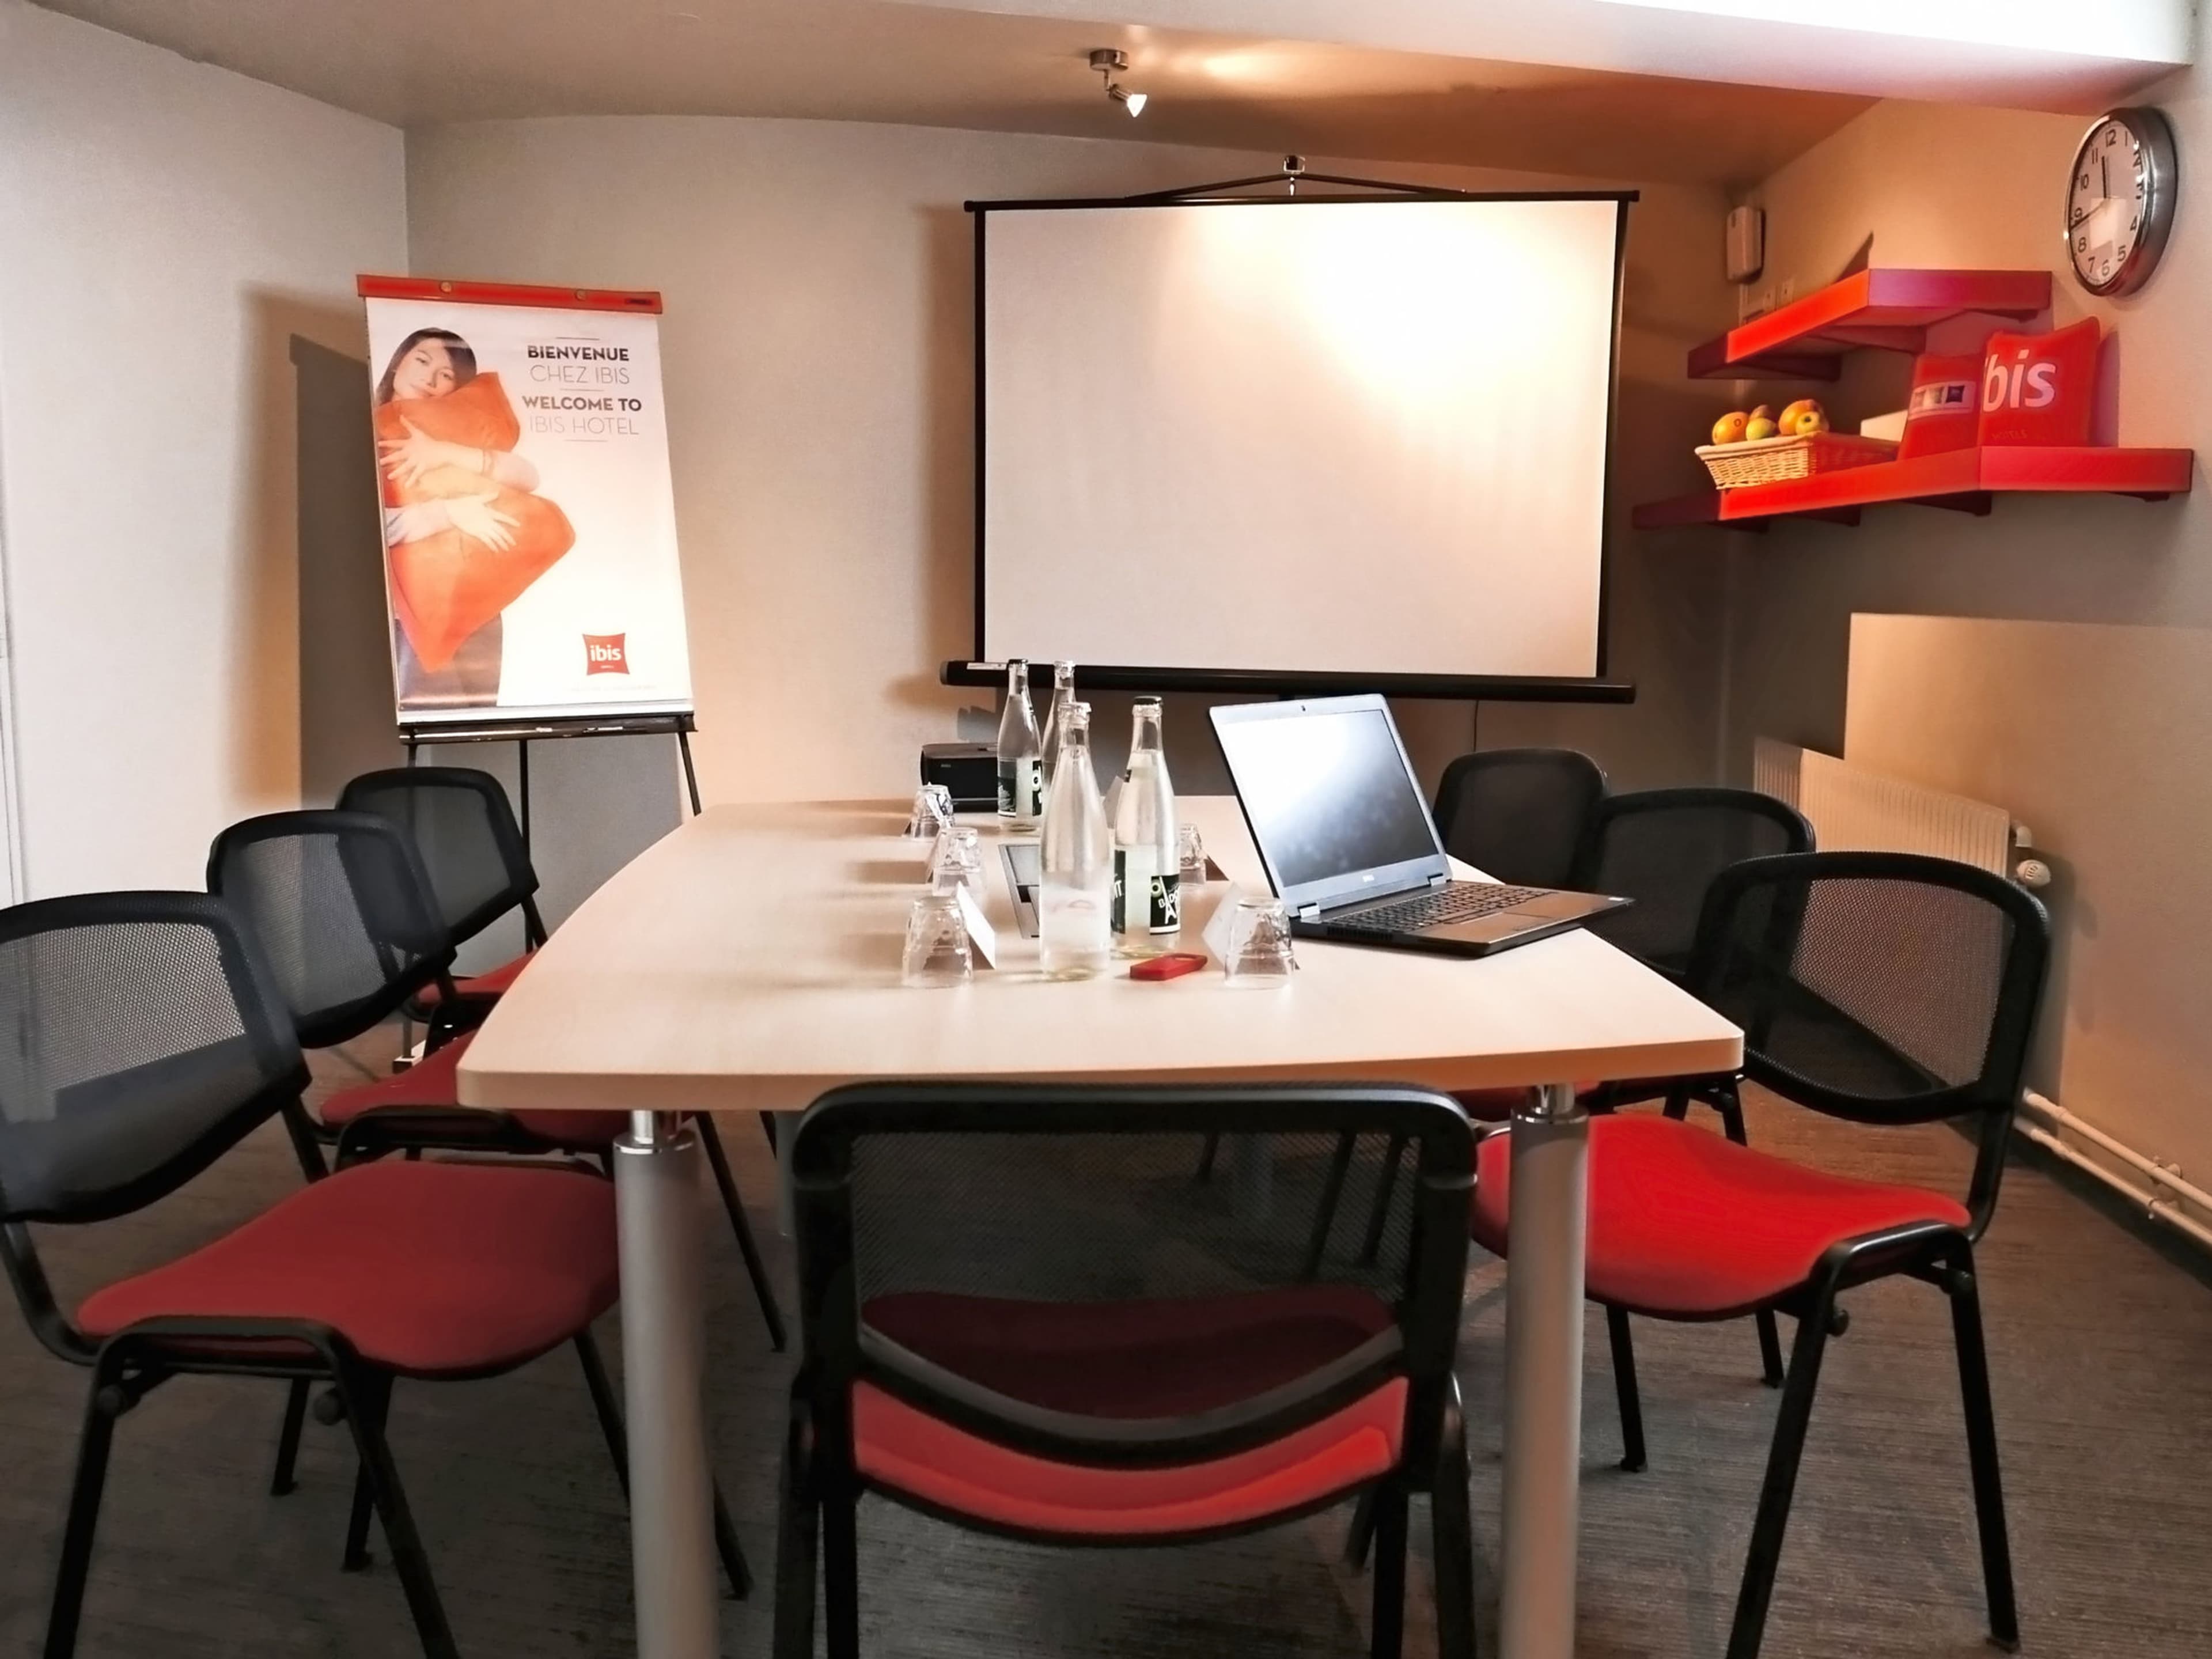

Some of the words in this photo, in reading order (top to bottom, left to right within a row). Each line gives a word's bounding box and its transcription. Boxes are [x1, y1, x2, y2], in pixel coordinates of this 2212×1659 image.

[2105, 129, 2116, 147] 12
[2124, 130, 2128, 146] 1
[2092, 148, 2099, 164] 11
[2081, 174, 2089, 191] 10
[2130, 215, 2138, 232] 4
[2078, 237, 2086, 252] 8
[2118, 245, 2126, 262] 5
[2088, 257, 2095, 273] 7
[2101, 260, 2110, 276] 6
[528, 346, 630, 361] BIENVENUE
[530, 365, 588, 384] CHEZ
[596, 367, 630, 385] IBIS
[522, 396, 613, 411] WELCOME
[618, 398, 642, 412] TO
[530, 415, 565, 433] IBIS
[573, 416, 639, 435] HOTEL
[590, 644, 622, 662] ibis
